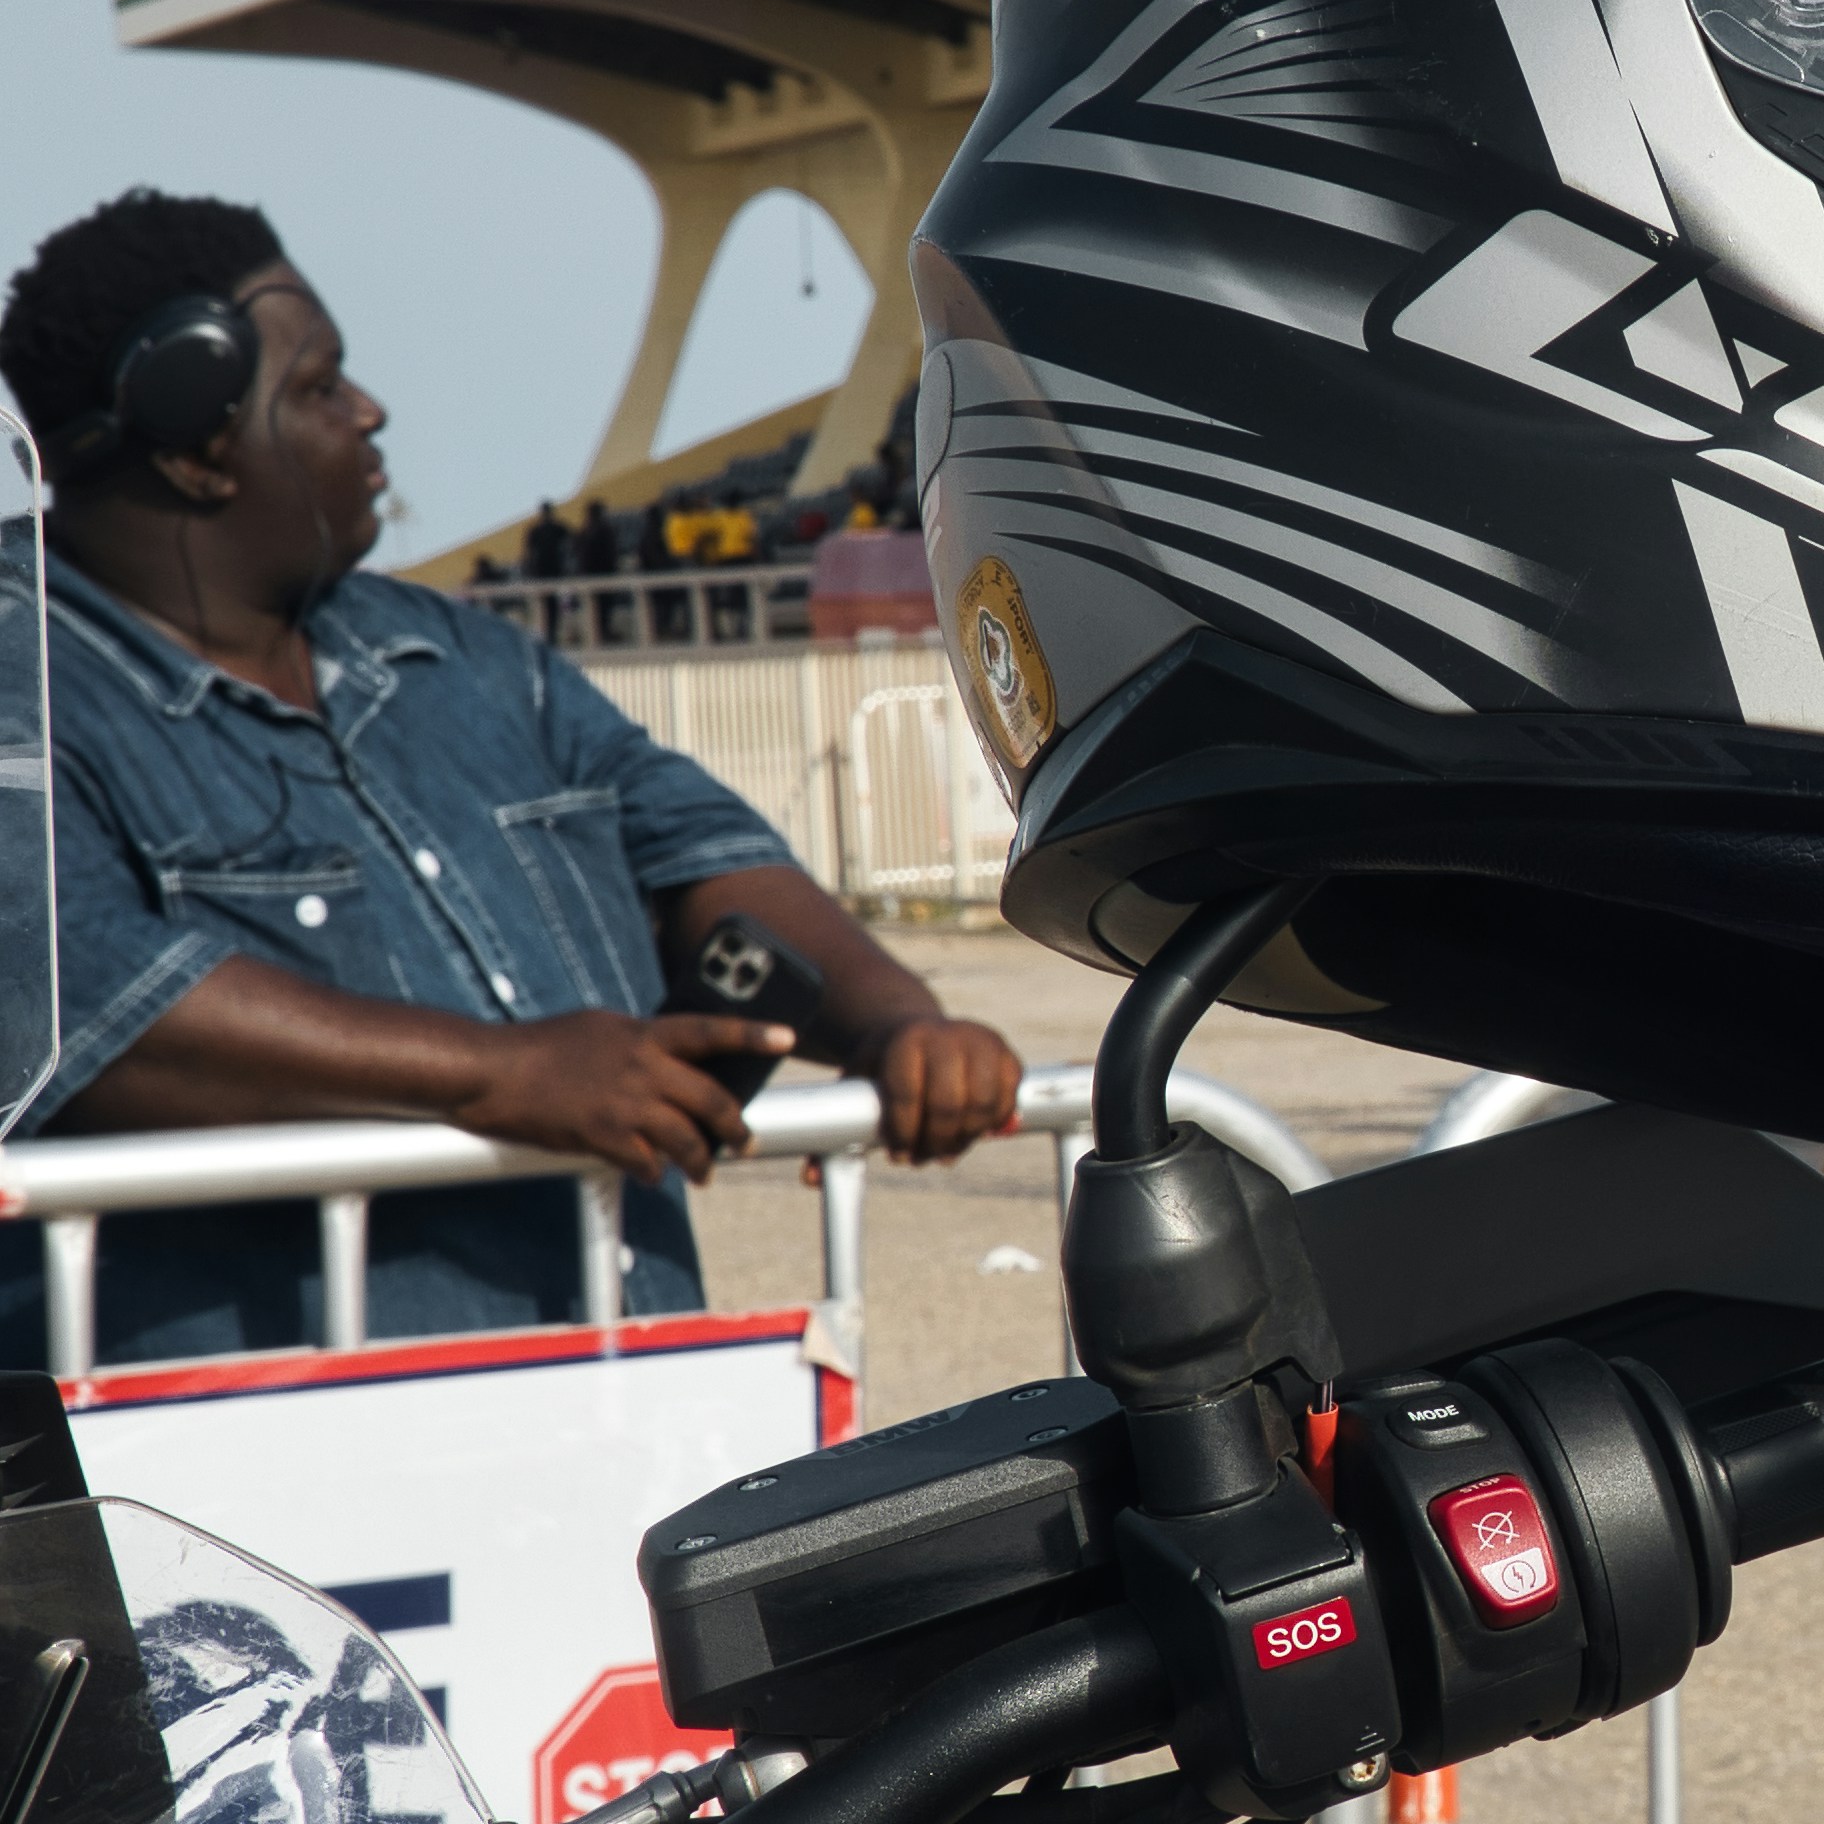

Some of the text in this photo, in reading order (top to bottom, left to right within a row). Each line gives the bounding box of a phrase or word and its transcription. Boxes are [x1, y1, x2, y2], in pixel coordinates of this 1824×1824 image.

[1407, 1404, 1459, 1422] MODE
[1459, 1477, 1500, 1494] STOP
[1267, 1612, 1342, 1658] SOS
